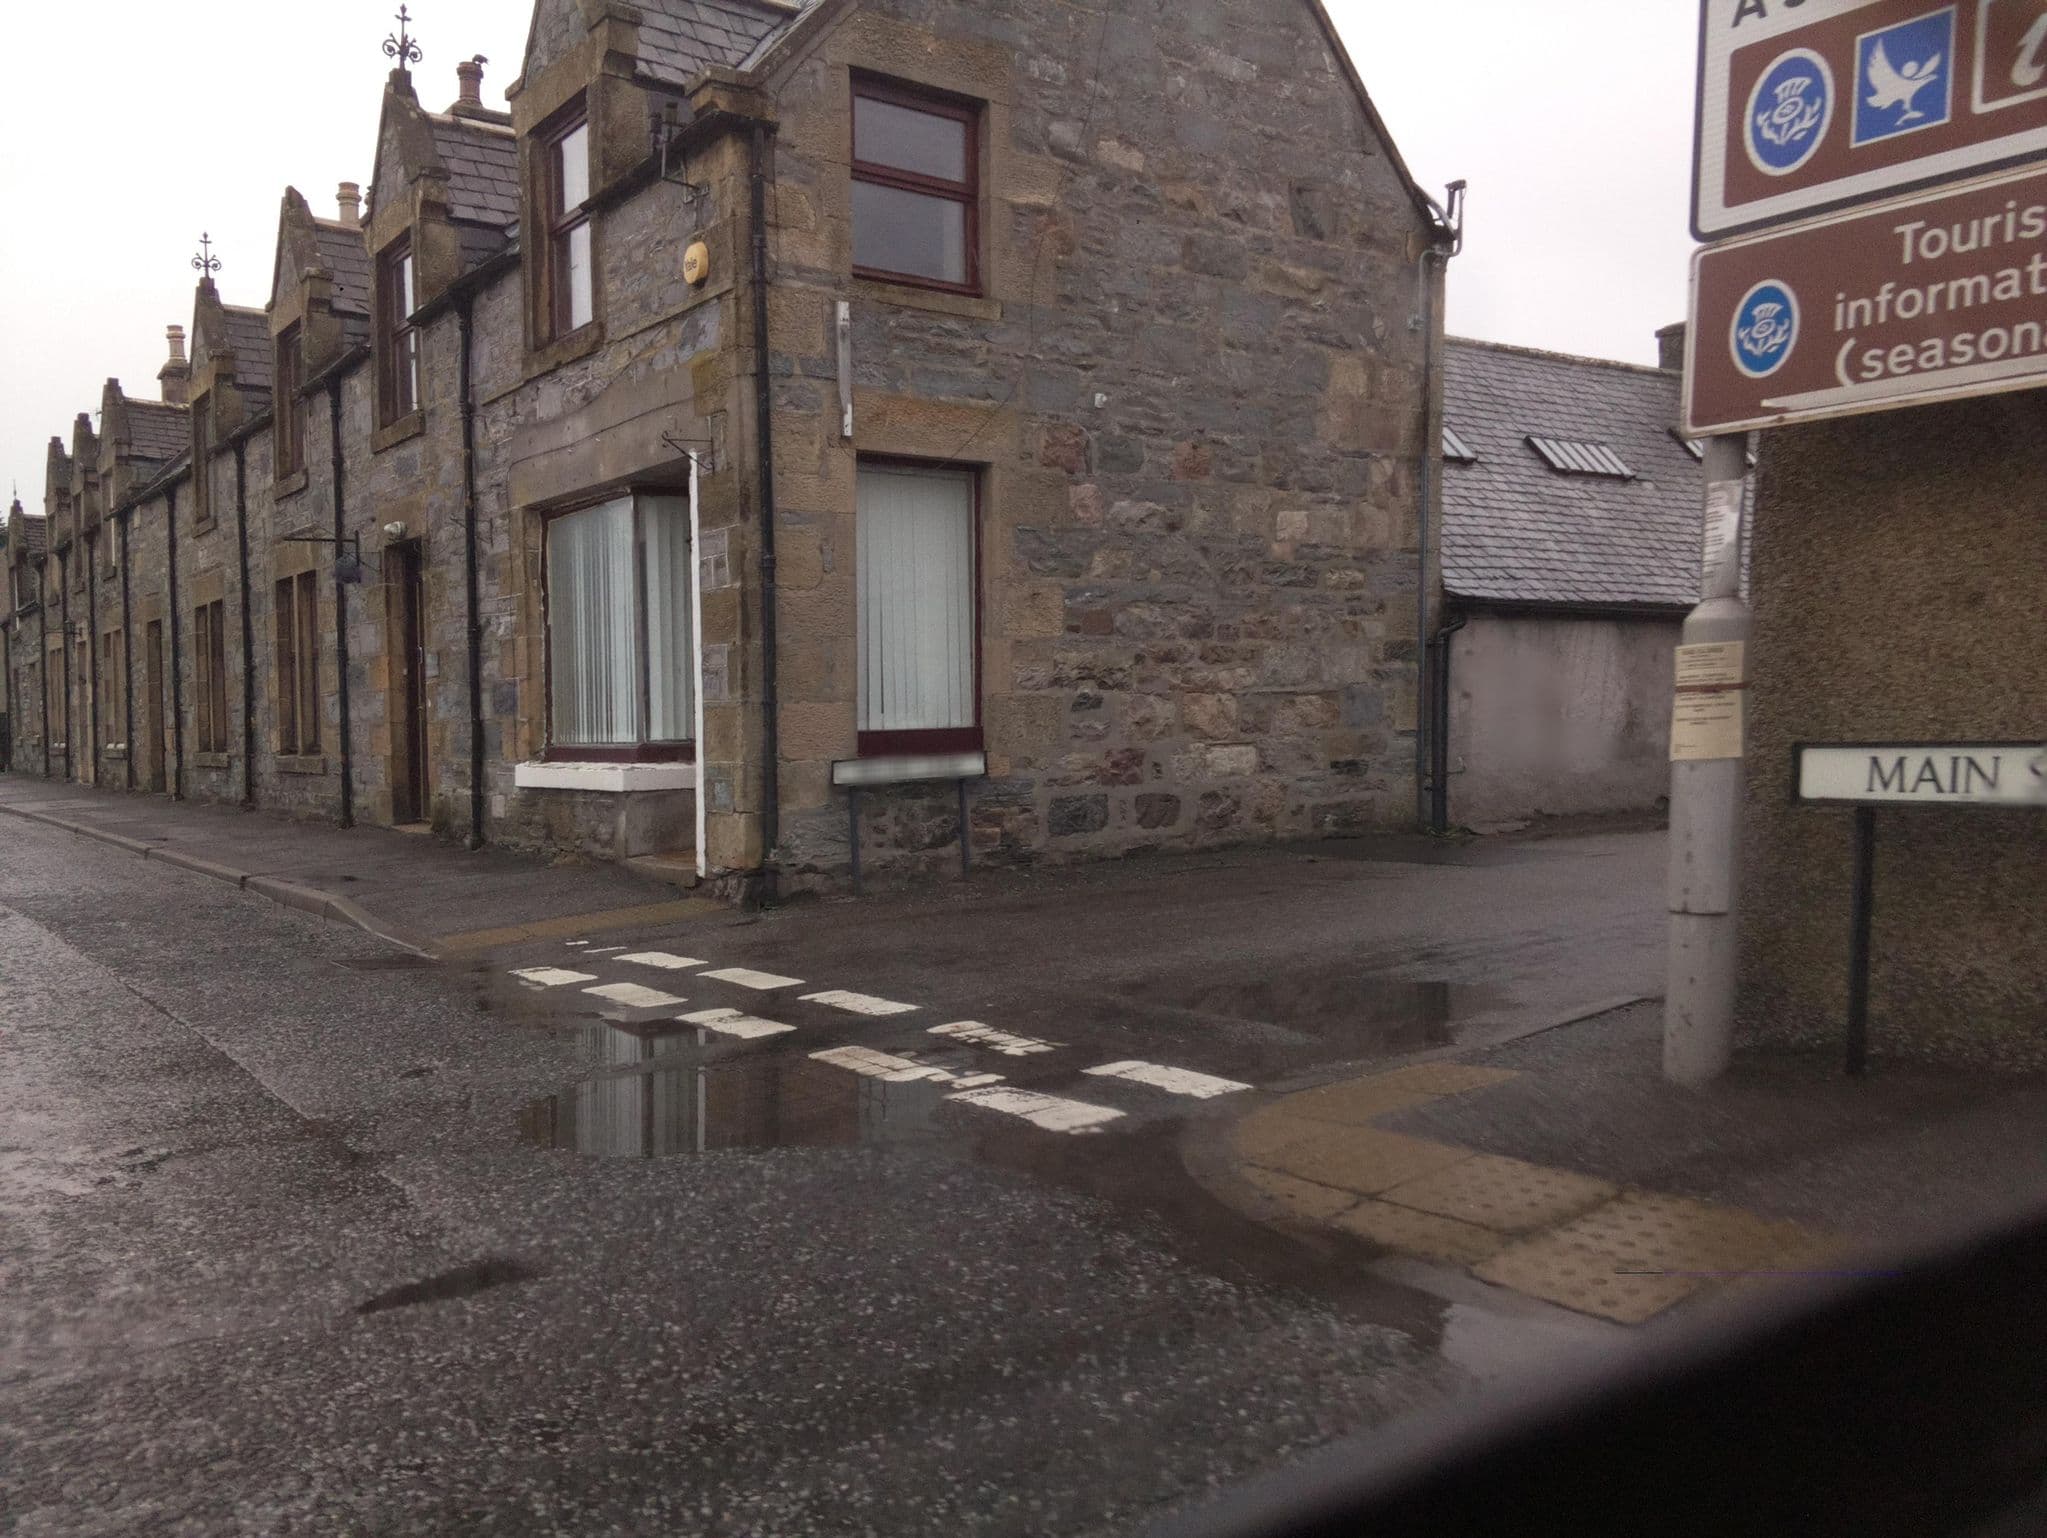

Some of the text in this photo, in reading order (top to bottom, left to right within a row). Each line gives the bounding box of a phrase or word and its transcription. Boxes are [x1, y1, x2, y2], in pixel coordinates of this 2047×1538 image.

[1834, 253, 2047, 332] informat
[1834, 319, 2047, 386] (season
[1866, 755, 2001, 794] MAIN
